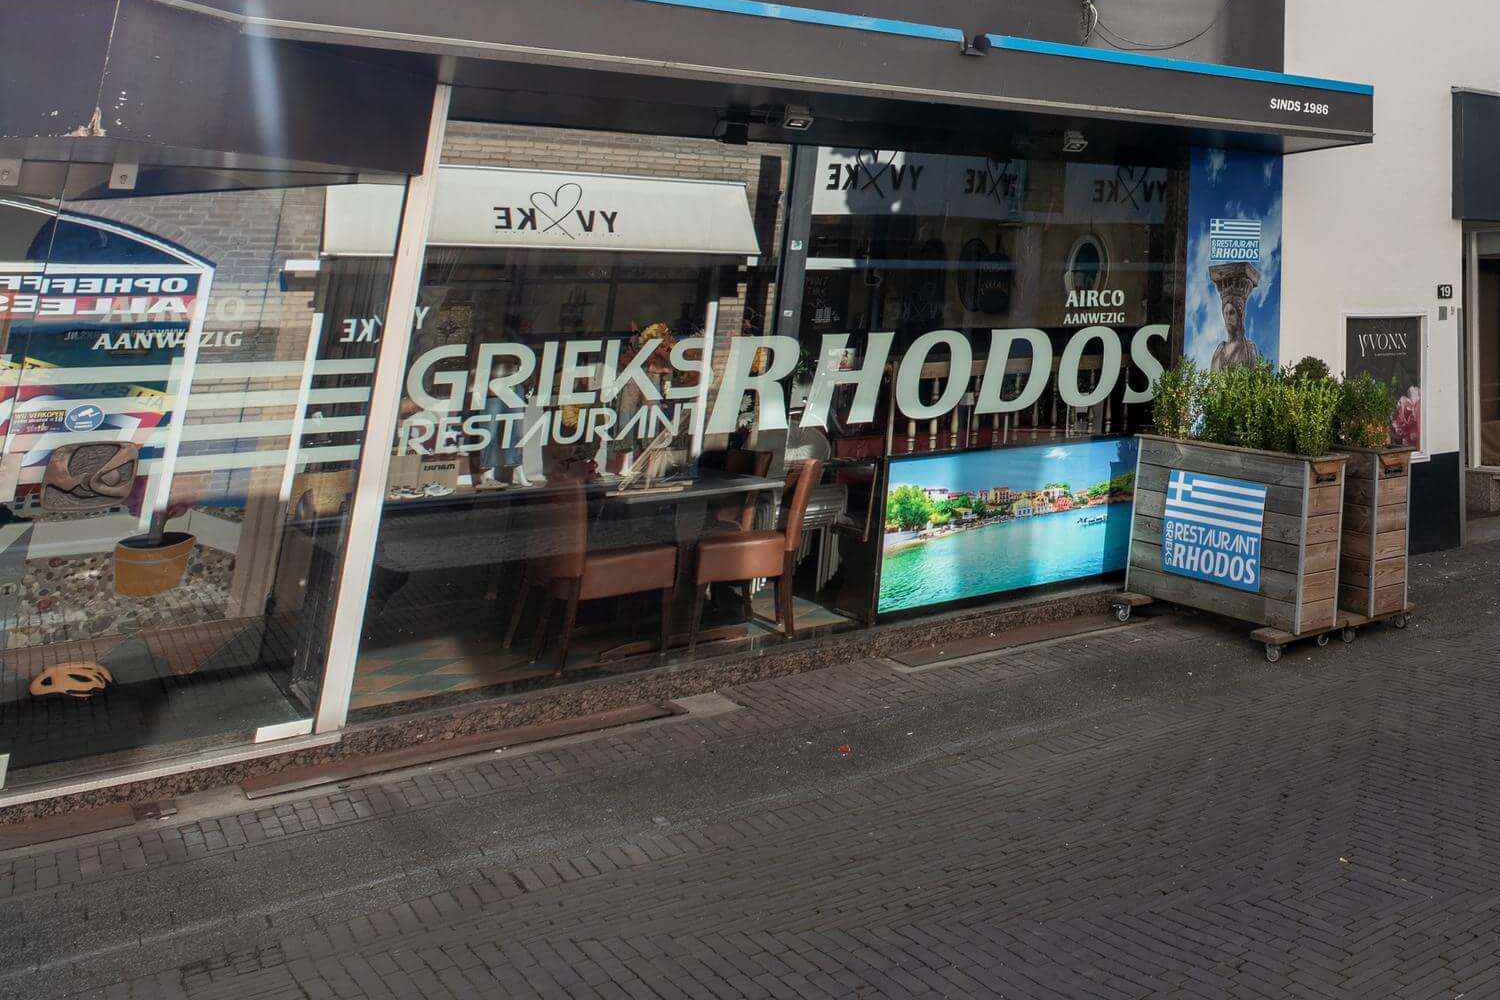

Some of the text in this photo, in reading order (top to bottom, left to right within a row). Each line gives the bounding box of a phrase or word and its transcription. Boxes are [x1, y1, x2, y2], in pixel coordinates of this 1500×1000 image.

[1270, 98, 1329, 115] SINDS 1986
[1216, 247, 1259, 259] RHODOS
[1217, 239, 1259, 248] RESTAURANT
[1065, 289, 1125, 308] AIRCO
[1440, 286, 1451, 297] 19
[1063, 311, 1125, 325] AANWEZIG
[406, 337, 715, 412] GRIEKS
[705, 323, 1170, 434] RHODOS
[400, 402, 702, 455] RESTAURANT
[1164, 520, 1174, 566] GRIEKS
[1174, 522, 1258, 556] RESTAURANT
[1172, 543, 1256, 585] RHODOS
